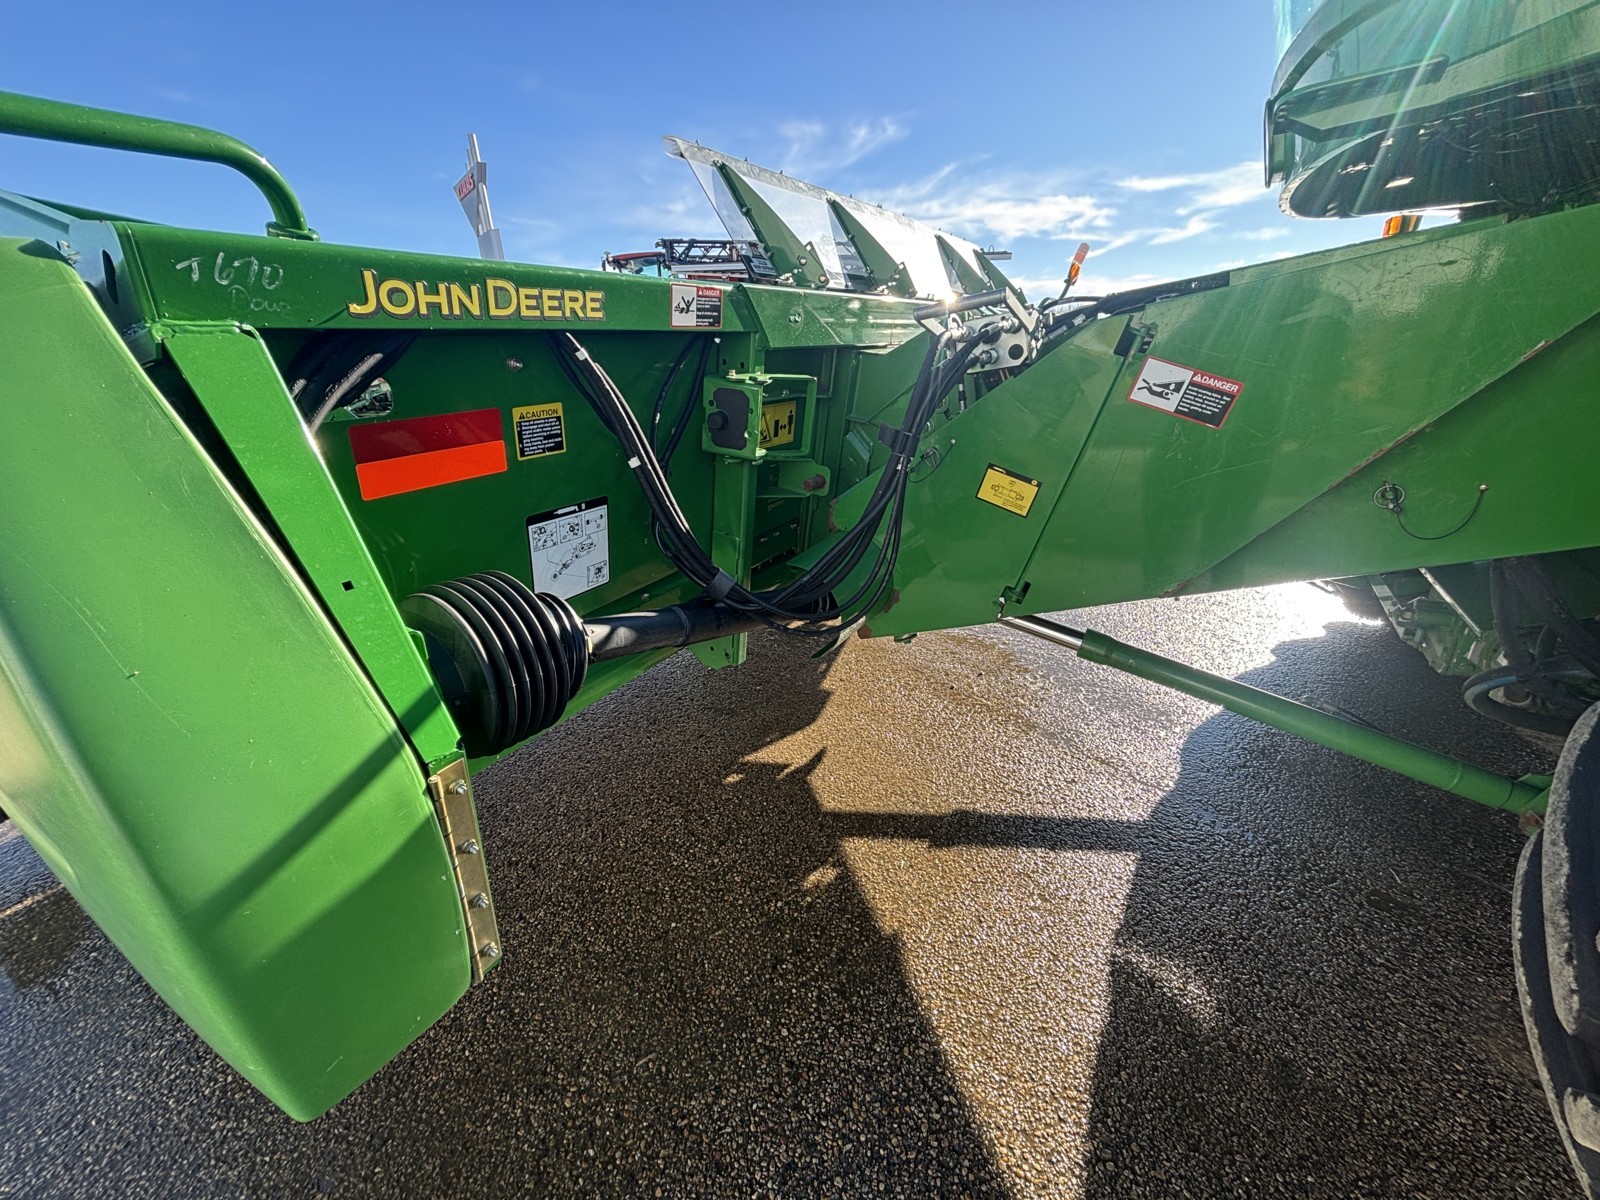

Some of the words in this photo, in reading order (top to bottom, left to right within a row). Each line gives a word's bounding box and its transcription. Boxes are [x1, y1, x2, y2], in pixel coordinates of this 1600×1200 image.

[347, 268, 484, 321] JOHN
[485, 277, 606, 321] DEERE
[703, 289, 720, 297] DANGER
[1201, 376, 1239, 393] DANGER
[525, 408, 558, 420] CAUTION
